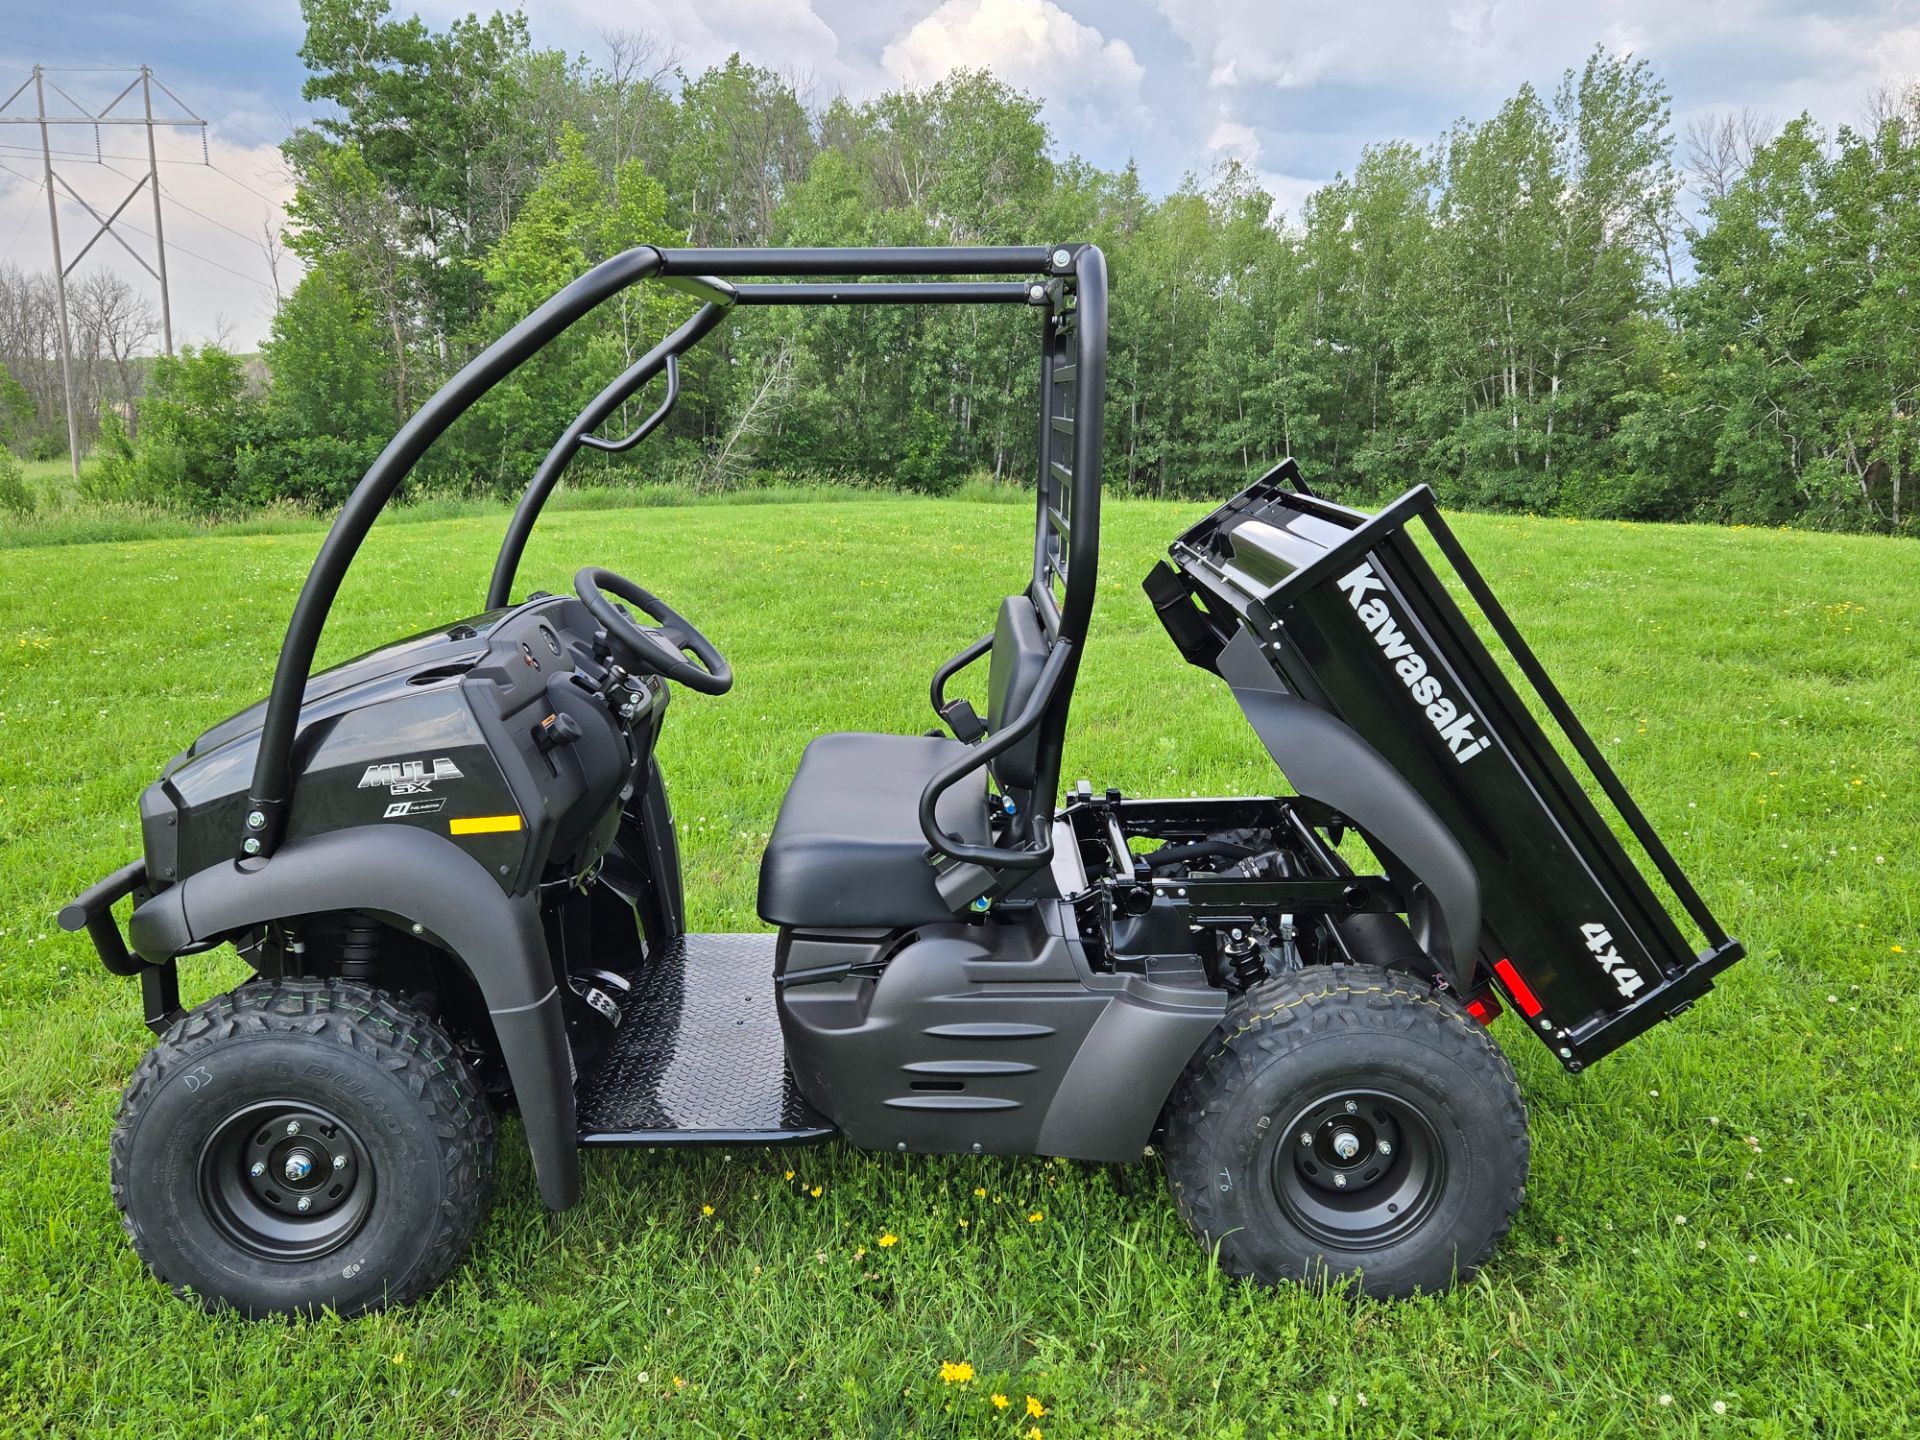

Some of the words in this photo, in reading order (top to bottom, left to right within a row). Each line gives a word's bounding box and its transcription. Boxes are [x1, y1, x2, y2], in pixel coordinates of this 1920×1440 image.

[1336, 561, 1492, 764] Kawasaki
[357, 757, 465, 789] MULE
[390, 781, 433, 795] SX
[1580, 922, 1645, 999] 4x4
[183, 1066, 213, 1093] D3
